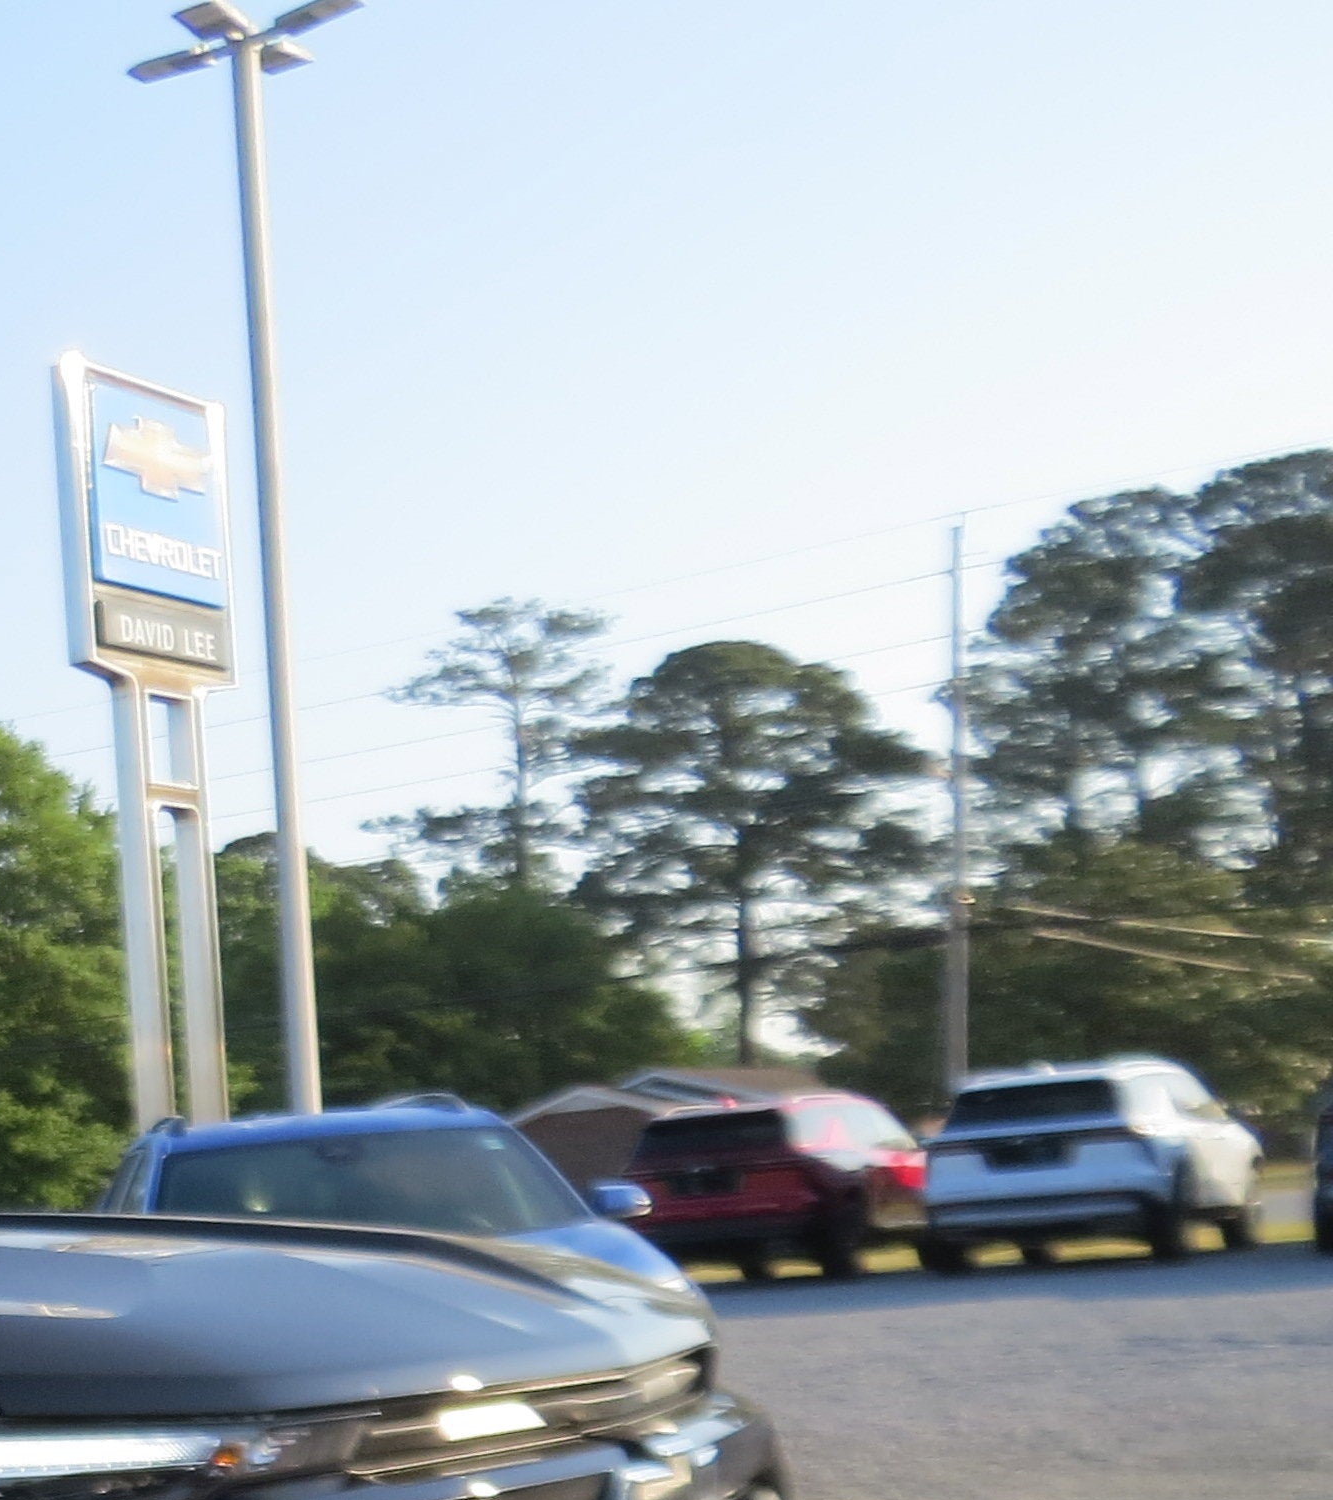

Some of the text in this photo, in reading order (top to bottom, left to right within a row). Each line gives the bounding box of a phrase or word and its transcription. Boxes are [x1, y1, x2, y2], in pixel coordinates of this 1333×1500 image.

[105, 523, 222, 580] CHEVROLET
[120, 614, 217, 661] DAVID LEE
